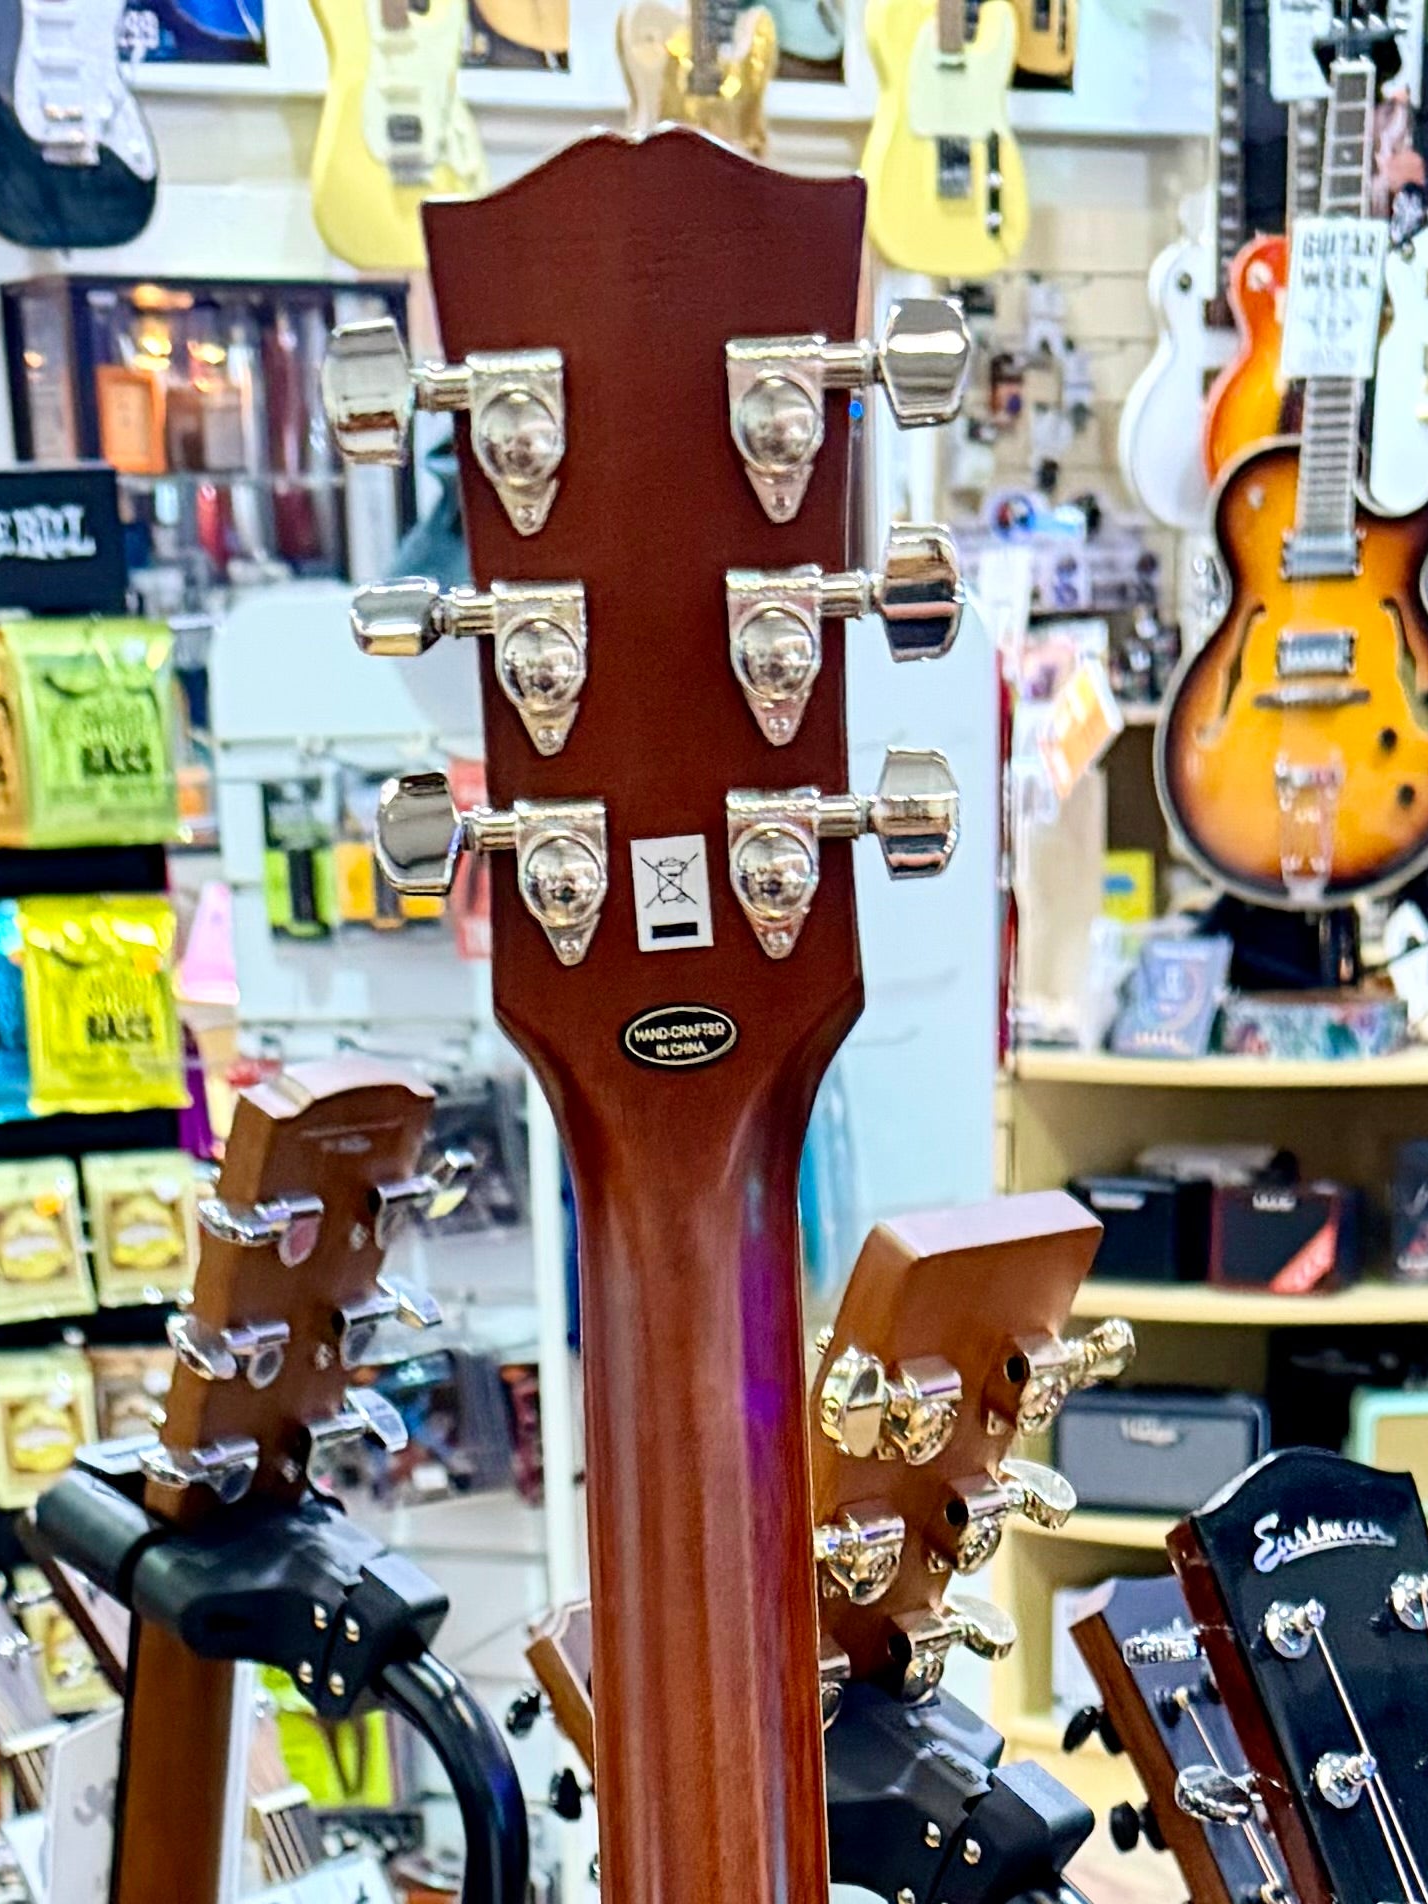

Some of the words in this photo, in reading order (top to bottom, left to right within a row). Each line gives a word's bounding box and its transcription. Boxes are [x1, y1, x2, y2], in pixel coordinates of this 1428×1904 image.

[634, 1021, 727, 1042] HAND-CRAFTED
[655, 1043, 670, 1057] IN
[670, 1040, 708, 1056] CHINA
[1252, 1511, 1398, 1574] Eastman
